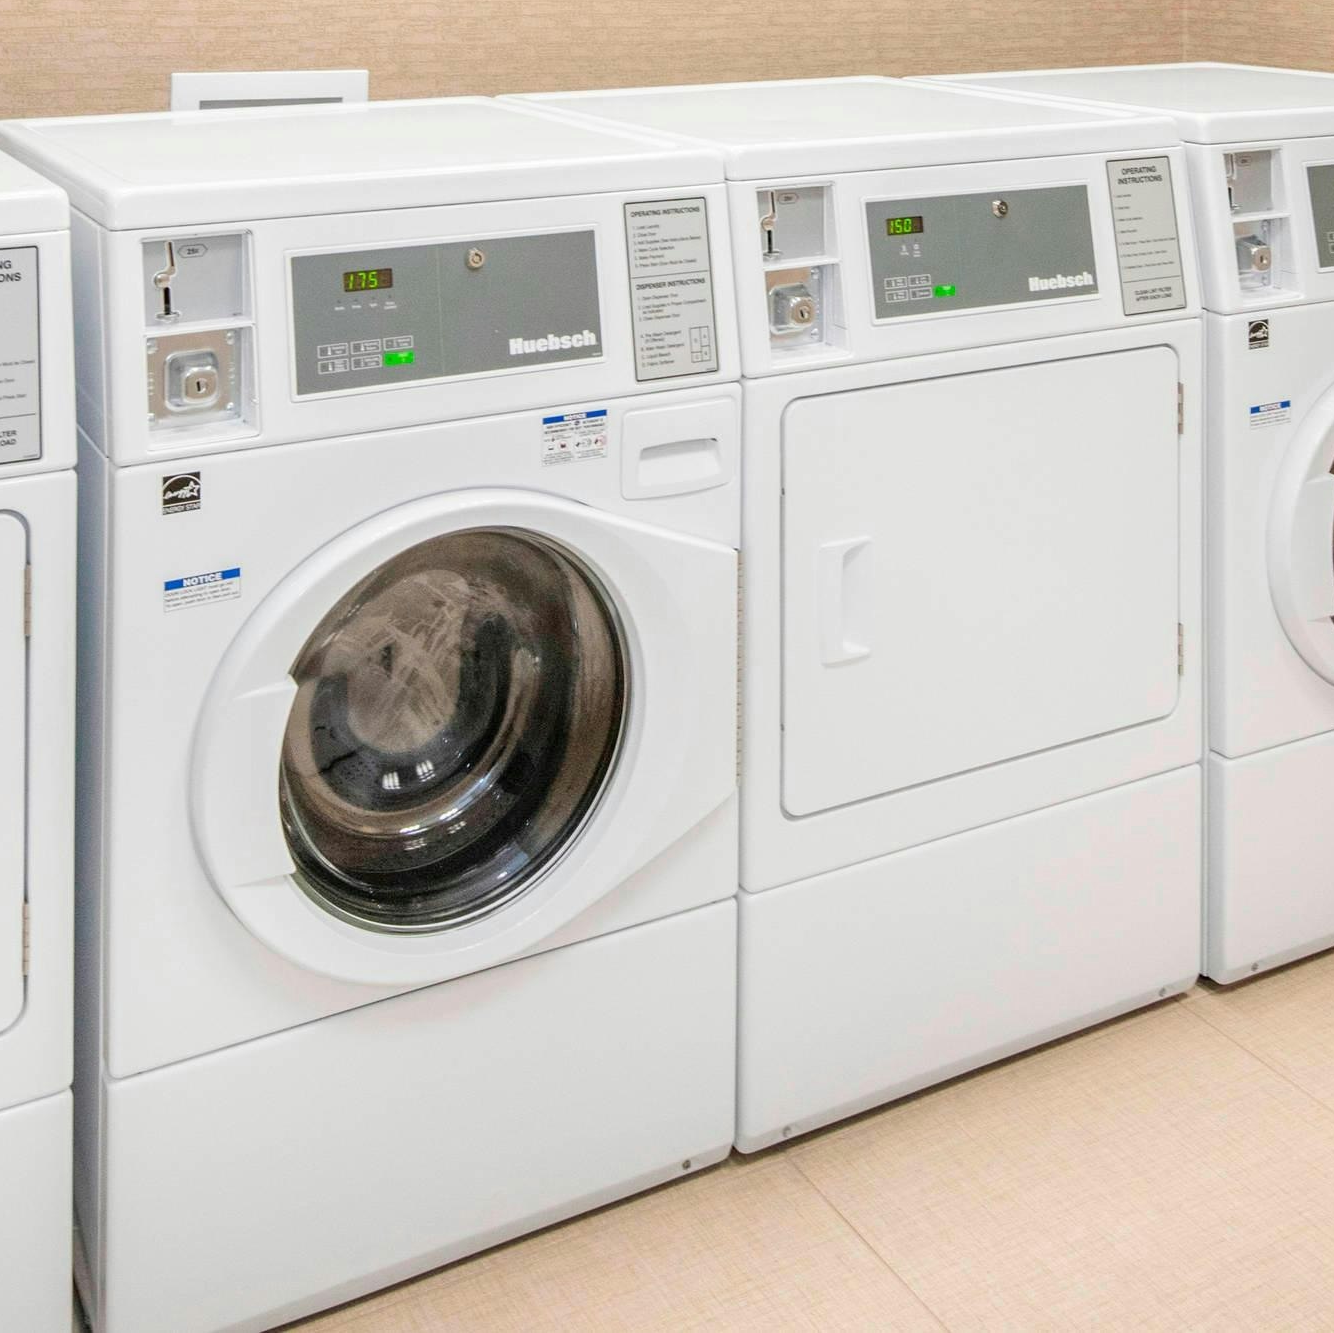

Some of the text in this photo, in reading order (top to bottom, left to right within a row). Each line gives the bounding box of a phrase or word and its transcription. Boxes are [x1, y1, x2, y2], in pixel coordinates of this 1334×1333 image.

[889, 218, 912, 234] 150
[349, 271, 378, 290] 175
[1028, 271, 1094, 292] Huebsch
[509, 329, 597, 355] Huebsch
[182, 572, 223, 587] NOTICE
